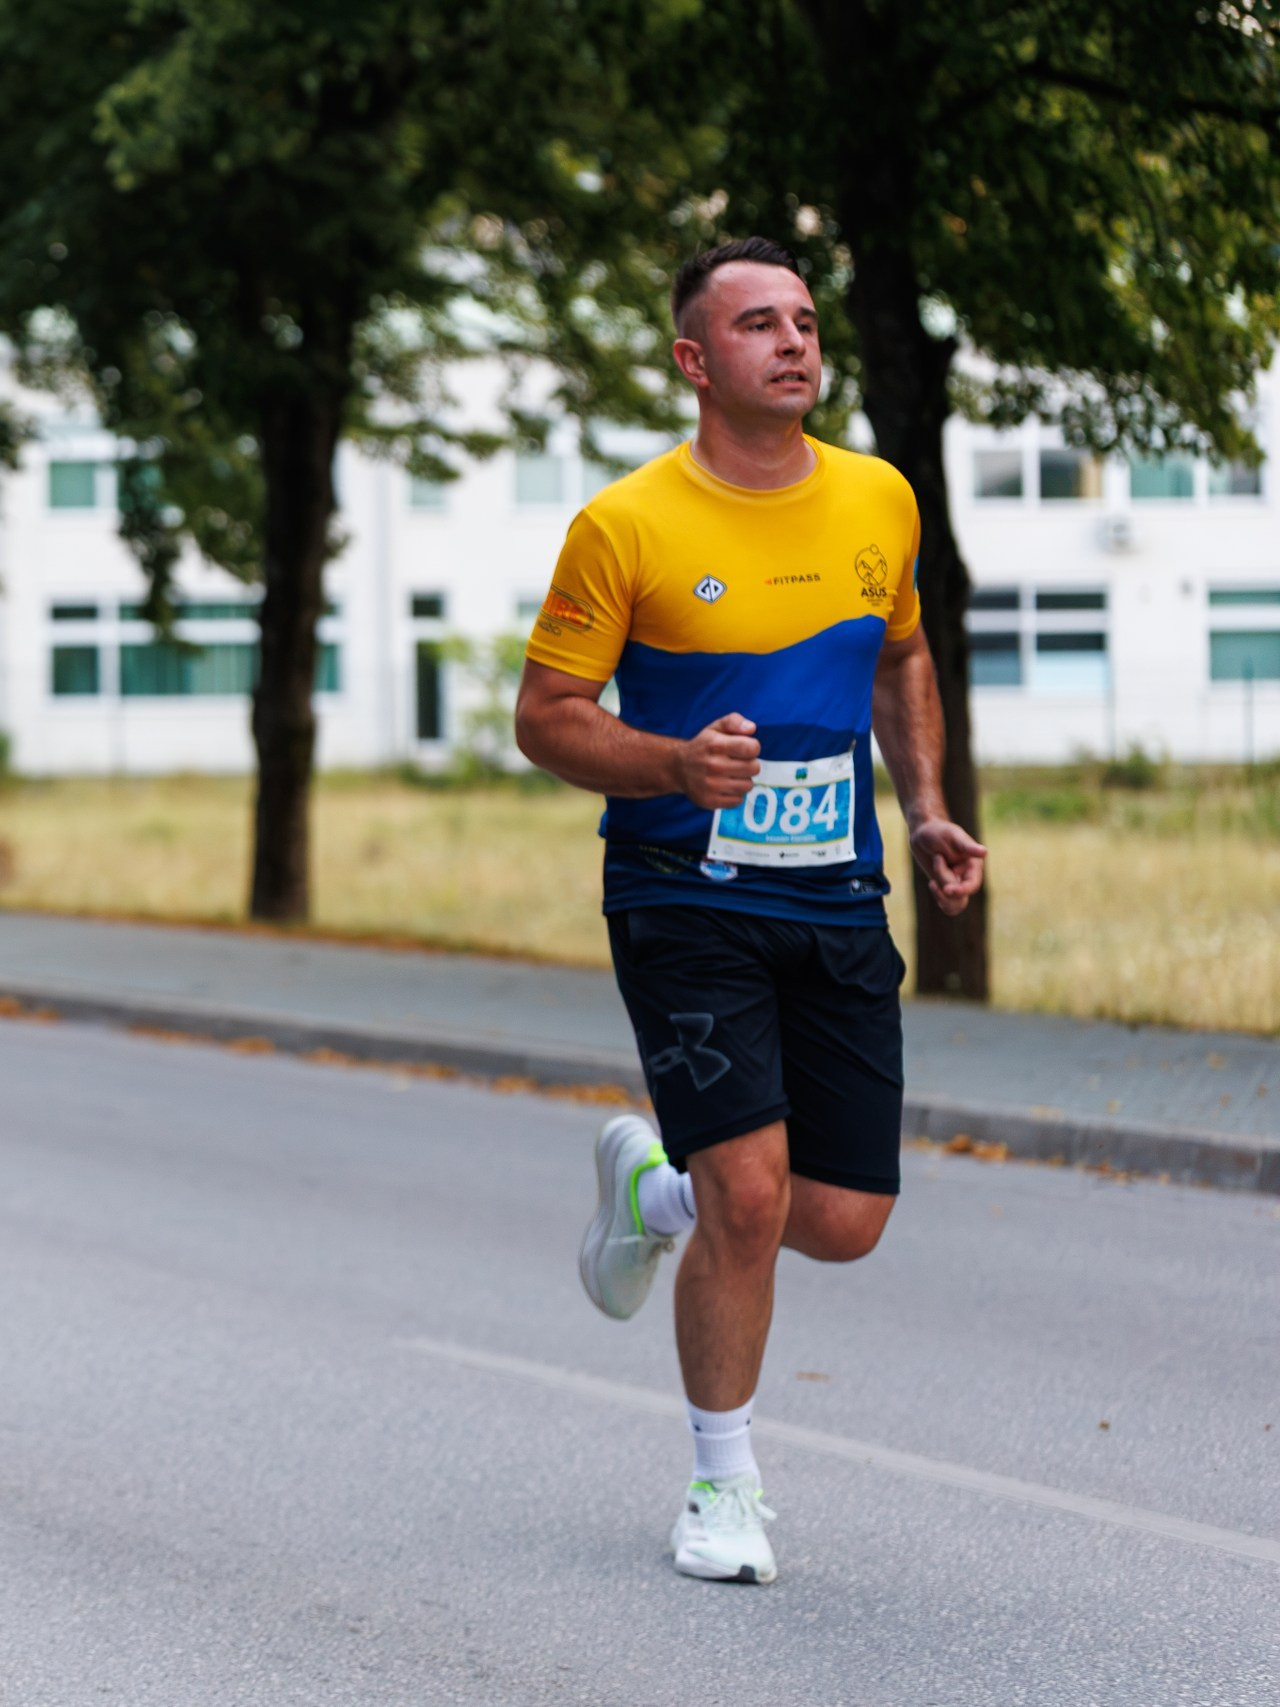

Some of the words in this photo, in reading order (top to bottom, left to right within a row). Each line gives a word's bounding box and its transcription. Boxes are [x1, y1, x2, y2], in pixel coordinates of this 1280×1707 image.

[773, 573, 821, 585] FITPASS
[861, 587, 887, 597] ASUS
[743, 782, 839, 834] 084
